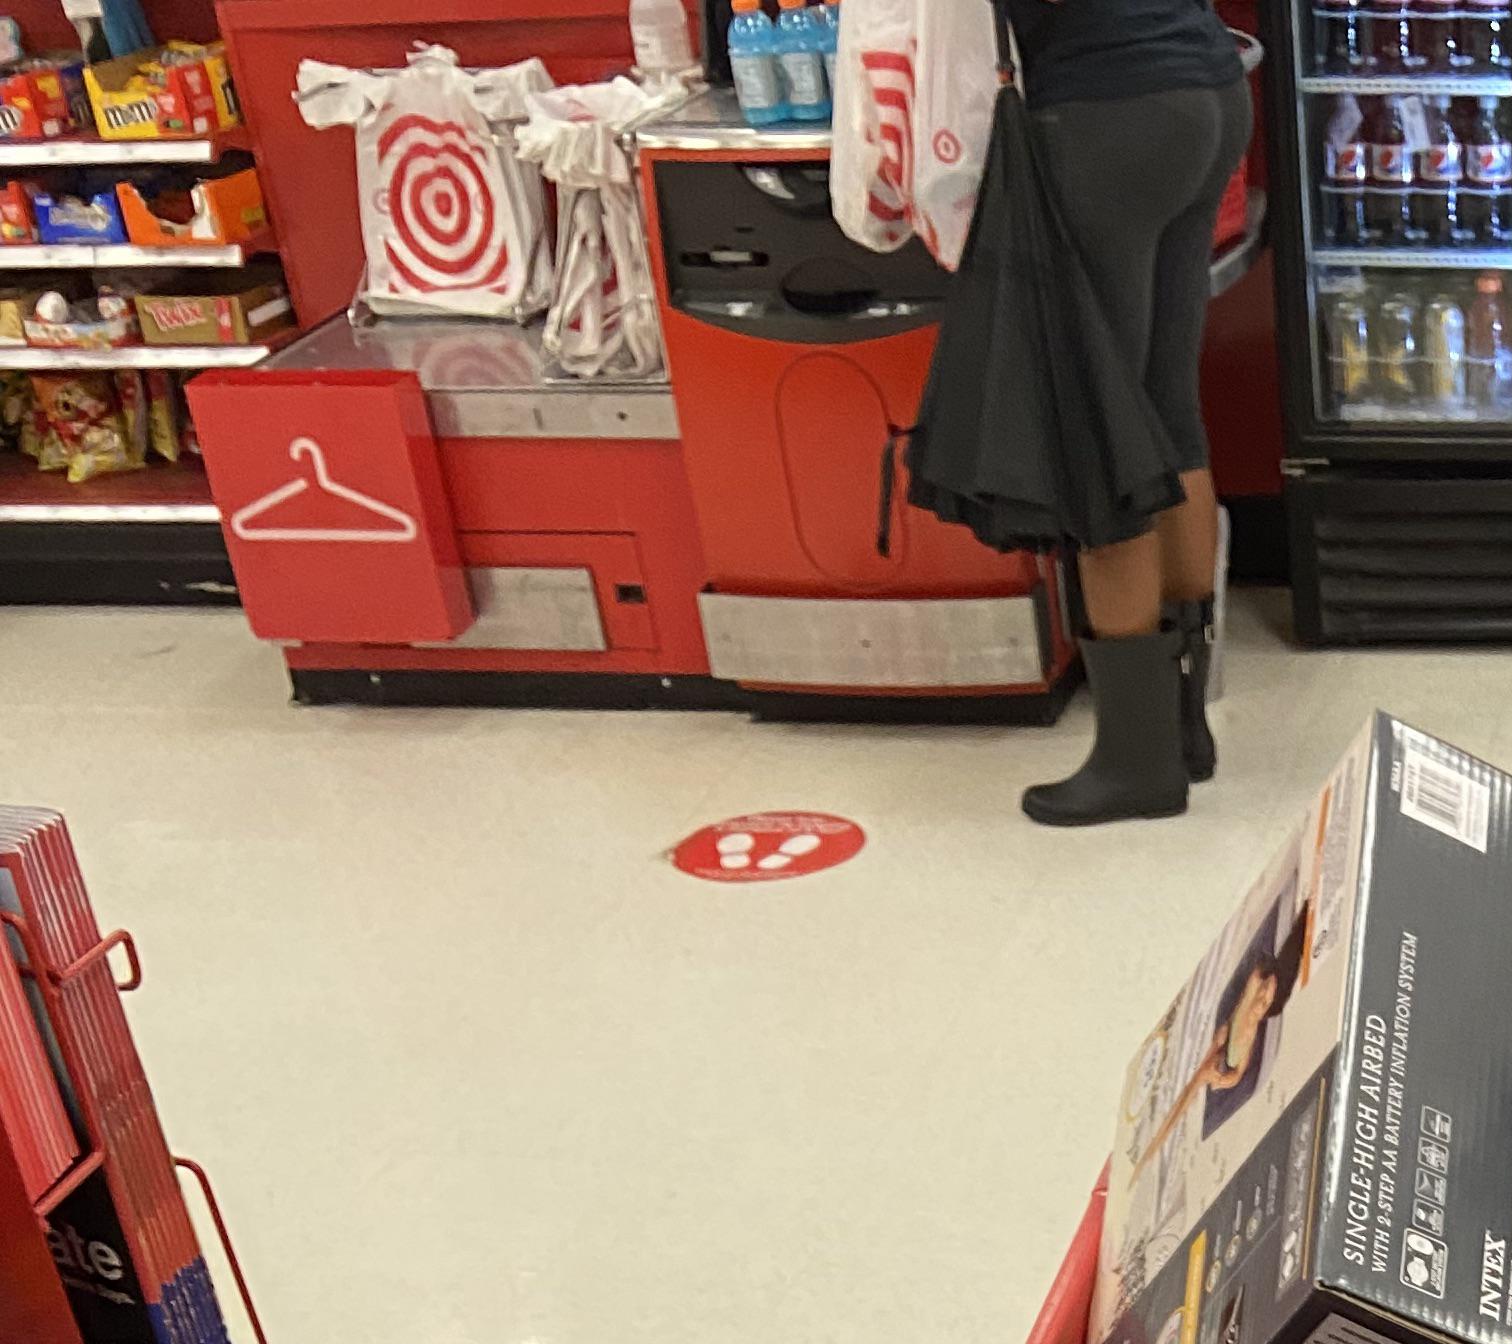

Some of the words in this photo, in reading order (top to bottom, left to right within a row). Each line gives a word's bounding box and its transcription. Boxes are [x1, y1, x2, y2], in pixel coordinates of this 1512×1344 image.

[1397, 929, 1418, 993] SYSTEM
[1358, 1010, 1387, 1101] AIRBED
[1389, 989, 1413, 1078] INFLATION
[1382, 1074, 1405, 1147] BATTERY
[1342, 1096, 1380, 1267] SINGLE-HIGH
[1380, 1142, 1399, 1174] AA
[1375, 1170, 1397, 1228] 2-STEP
[1370, 1225, 1392, 1277] WITH
[1478, 1229, 1506, 1322] INTEX
